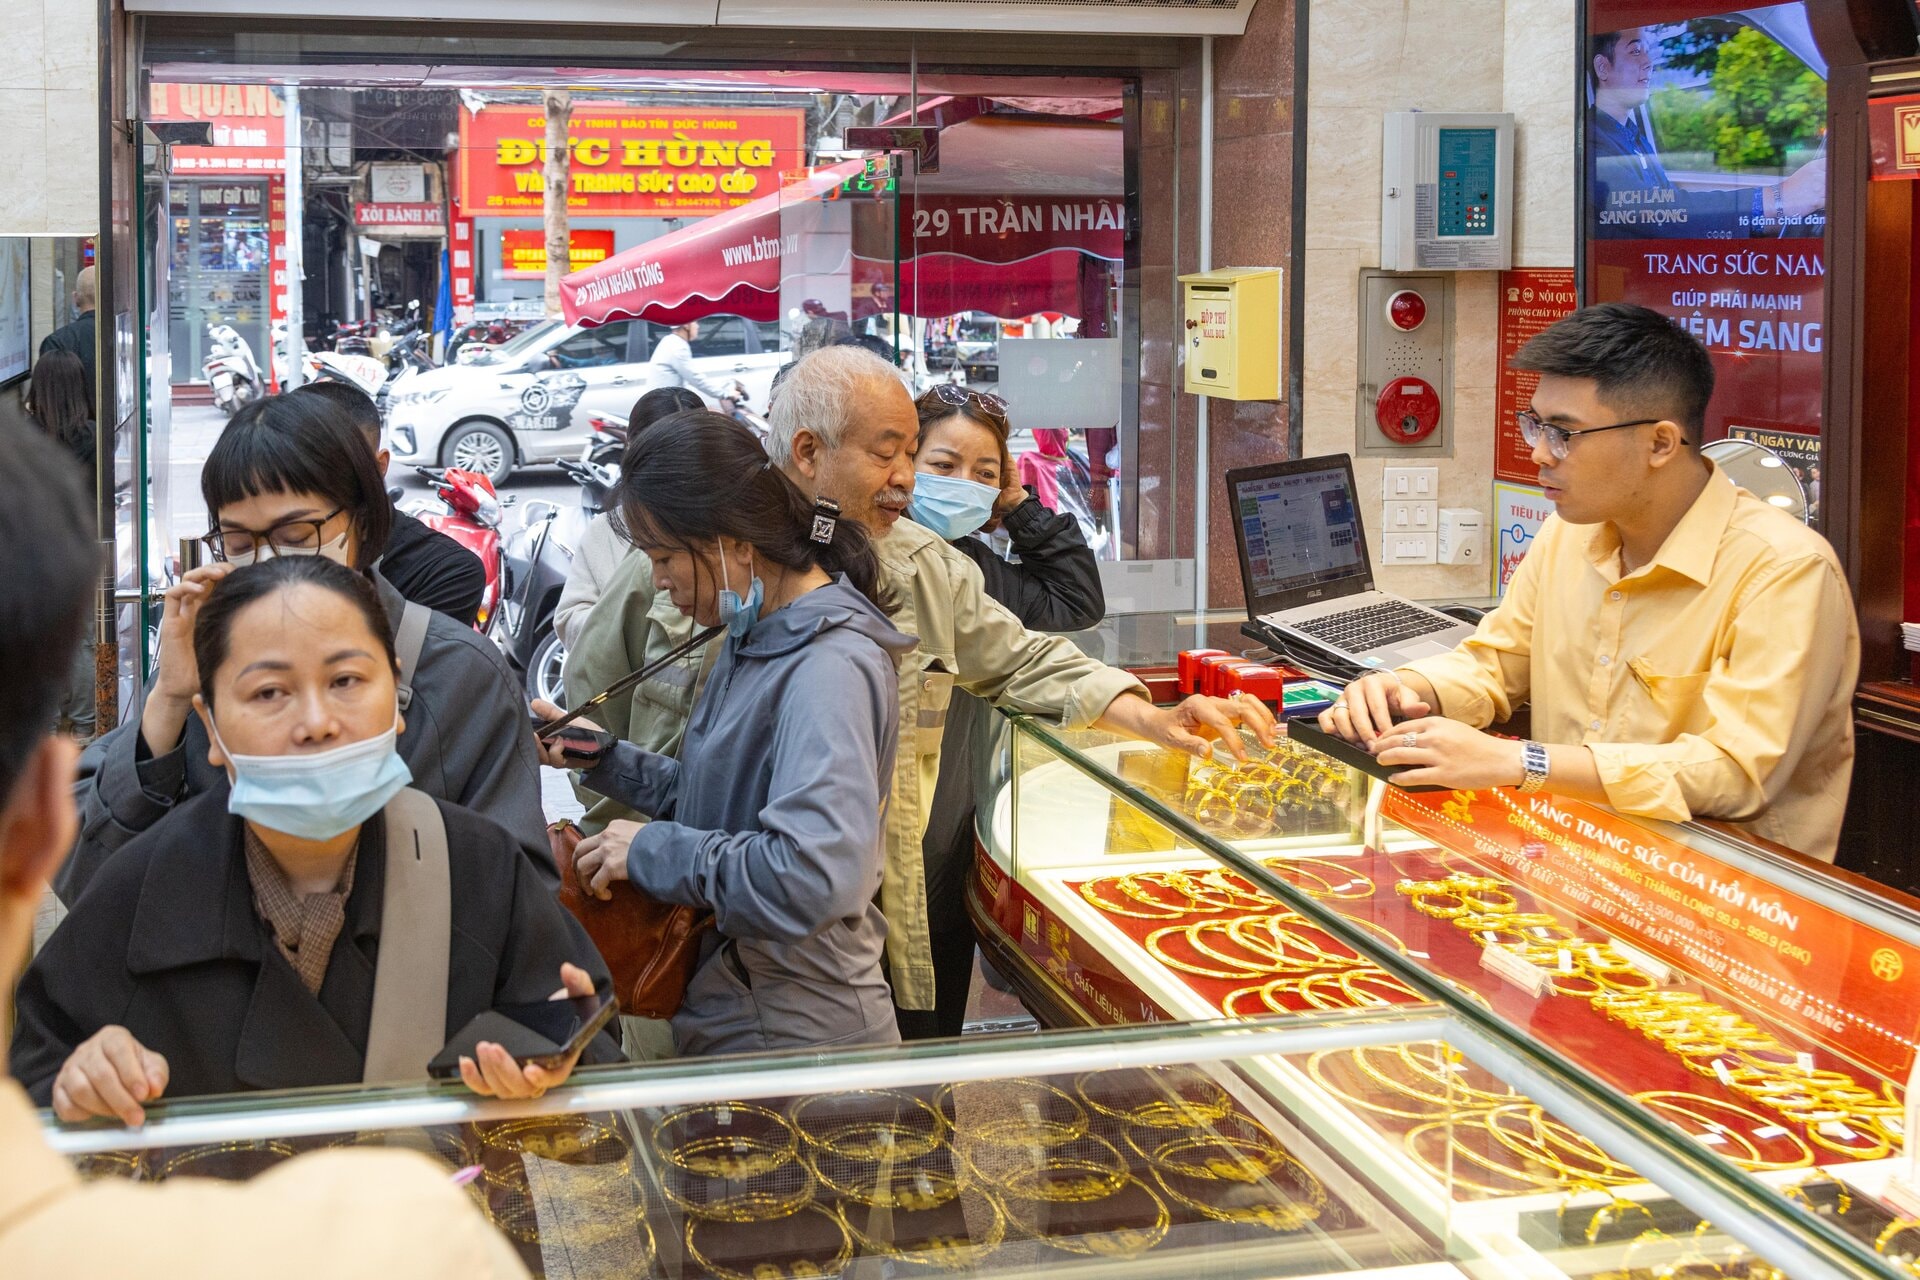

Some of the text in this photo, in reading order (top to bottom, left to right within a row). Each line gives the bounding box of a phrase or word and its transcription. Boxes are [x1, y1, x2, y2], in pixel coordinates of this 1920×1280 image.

[585, 119, 617, 128] TNHH
[621, 131, 776, 167] HÙNG
[572, 173, 635, 193] TRANG
[638, 169, 674, 193] SỨC
[677, 173, 716, 193] CAO
[719, 167, 757, 194] CẤP
[1611, 186, 1675, 208] LỊCH LÃM
[360, 205, 384, 222] XÔI
[387, 205, 422, 222] BÁNH
[912, 208, 949, 237] 29
[957, 199, 1042, 235] TRẦN
[1599, 208, 1687, 226] SANG TRỌNG
[1739, 216, 1749, 226] tô
[1752, 215, 1775, 228] đậm
[1644, 250, 1825, 276] TRANG SỨC NAM
[575, 287, 588, 307] 29
[634, 261, 664, 289] TÔNG
[1538, 289, 1554, 303] NỘI
[1555, 292, 1575, 304] QUY
[1672, 288, 1801, 313] GIÚP PHÁI MẠNH
[1738, 319, 1822, 353] SANG
[1760, 434, 1794, 449] NGÀY
[1796, 438, 1820, 452] VÀN
[1530, 797, 1799, 931] VÀNG TRANG SỨC CỦA HỒI MÔN
[1617, 911, 1644, 931] MAY
[1682, 895, 1716, 918] LONG
[1715, 911, 1739, 930] 99.9
[1746, 925, 1778, 948] 999.9
[1074, 972, 1130, 1025] CHẤT LIỆU BẰN
[1140, 1001, 1160, 1023] VÀ
